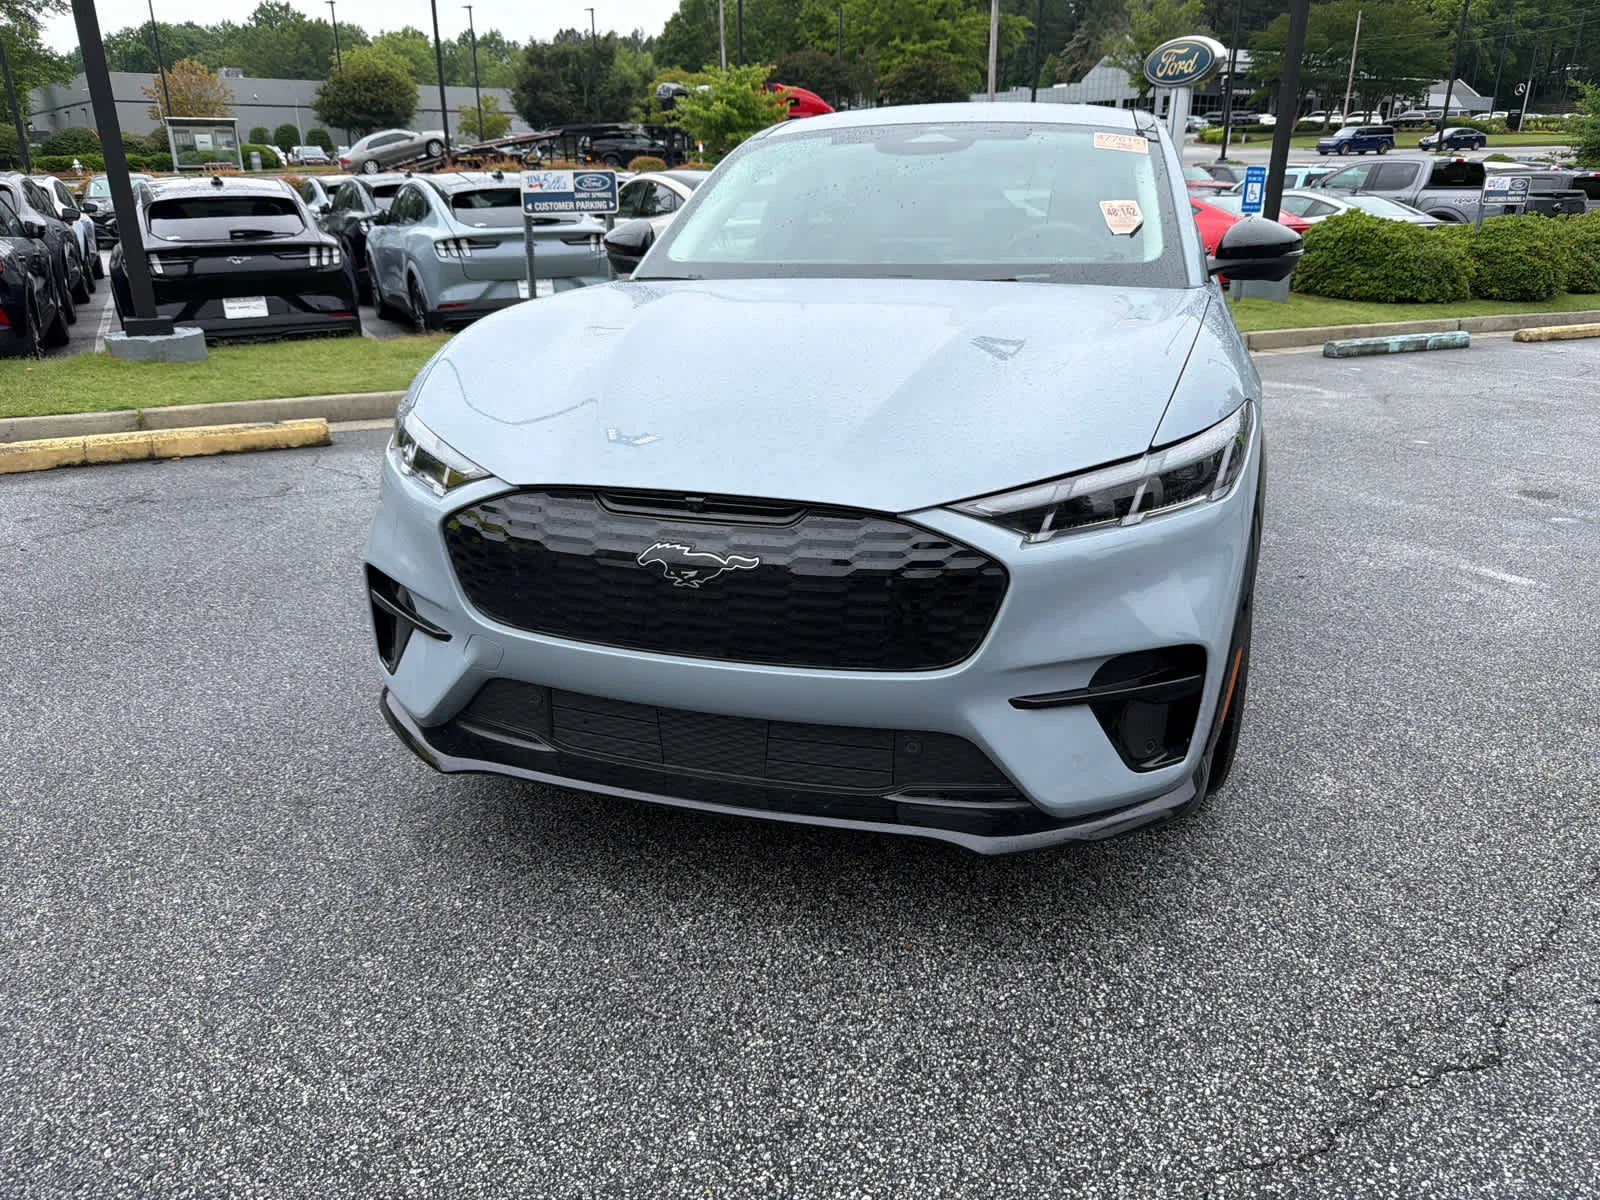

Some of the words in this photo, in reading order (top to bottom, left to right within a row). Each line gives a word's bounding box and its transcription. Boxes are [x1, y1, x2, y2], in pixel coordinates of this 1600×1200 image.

[1156, 47, 1199, 77] Ford
[582, 176, 602, 188] Ford
[534, 202, 574, 210] CUSTOMER
[576, 200, 607, 209] PARKING
